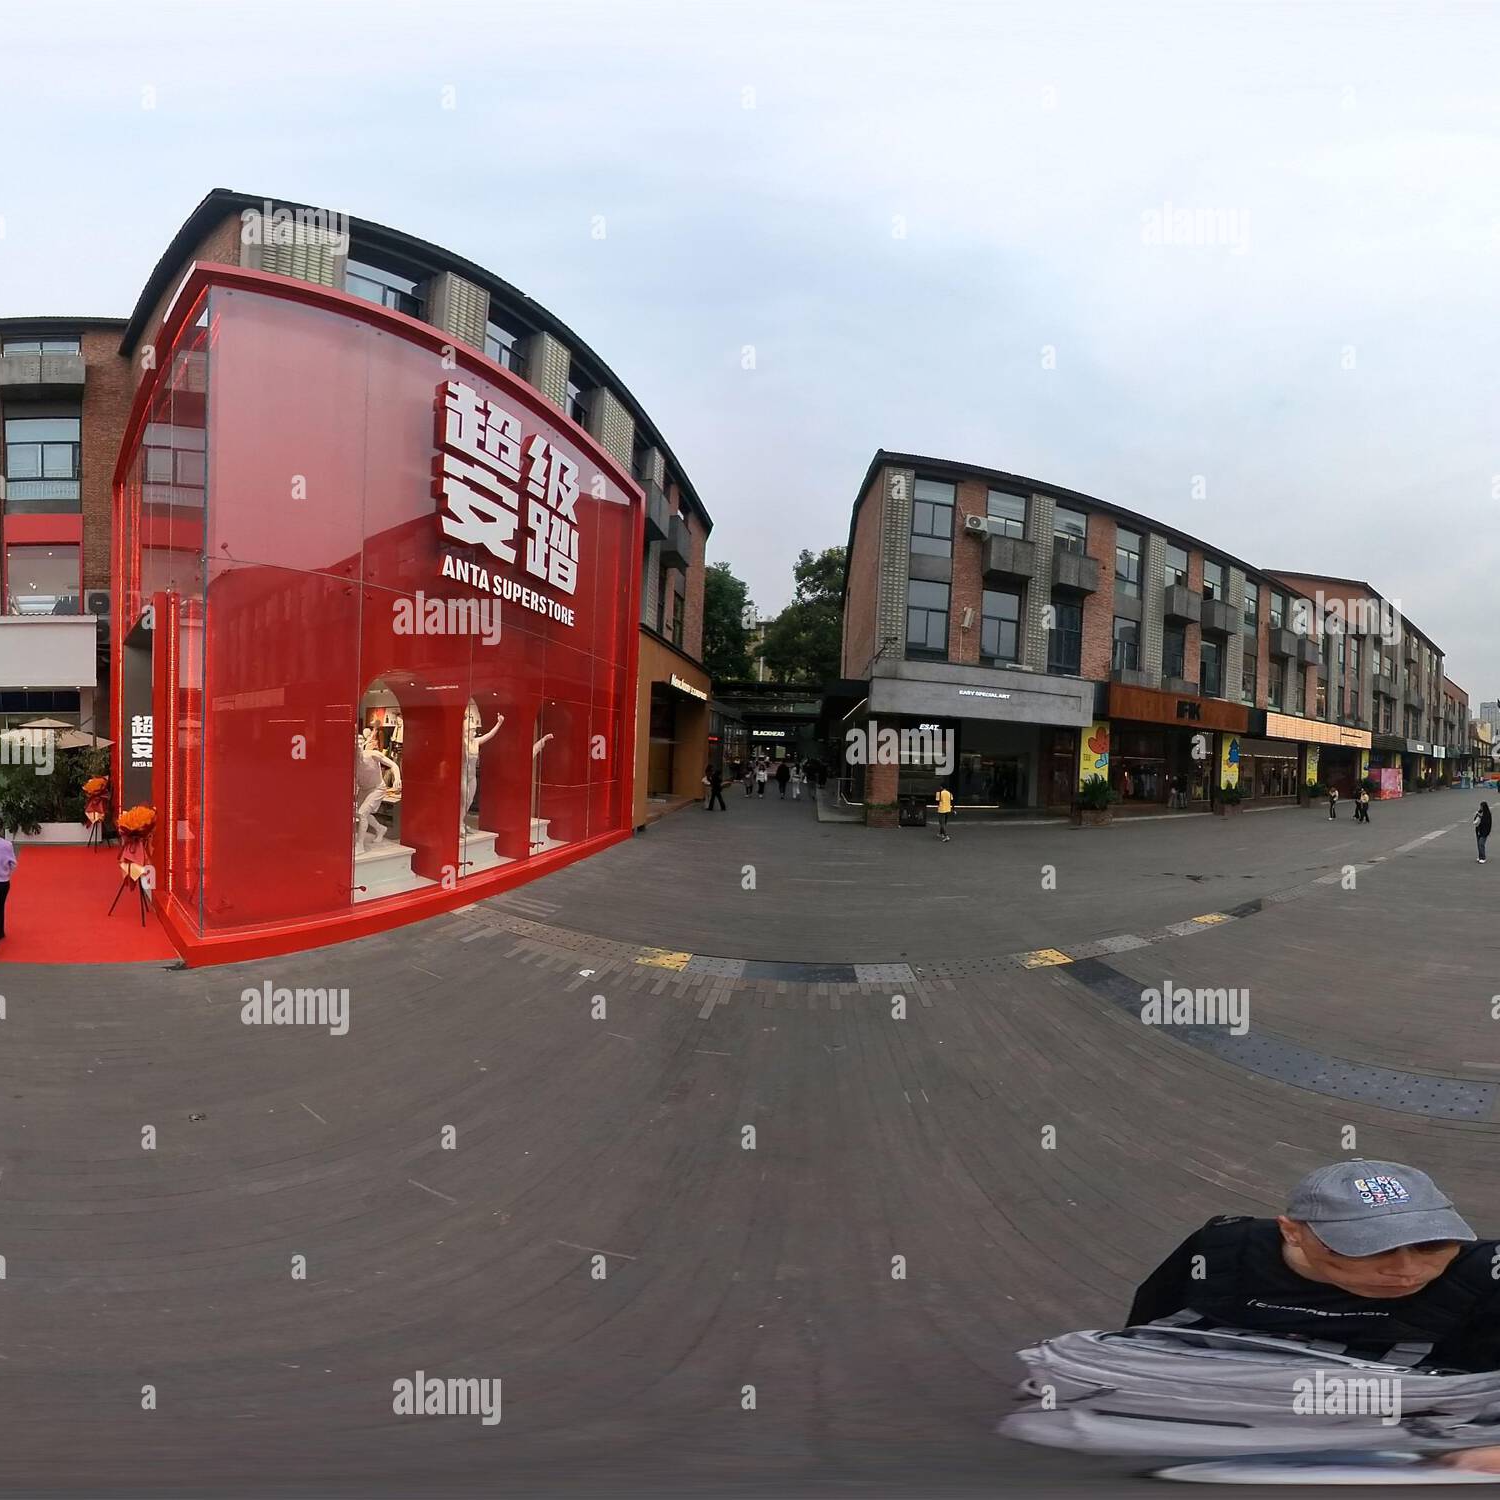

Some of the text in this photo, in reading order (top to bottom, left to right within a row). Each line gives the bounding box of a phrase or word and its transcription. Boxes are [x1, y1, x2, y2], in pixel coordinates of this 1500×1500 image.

[445, 381, 579, 524] 超级
[441, 453, 579, 595] 安踏
[442, 554, 575, 627] ANTA SUPERSTORE
[132, 715, 153, 737] 超
[132, 738, 153, 758] 安
